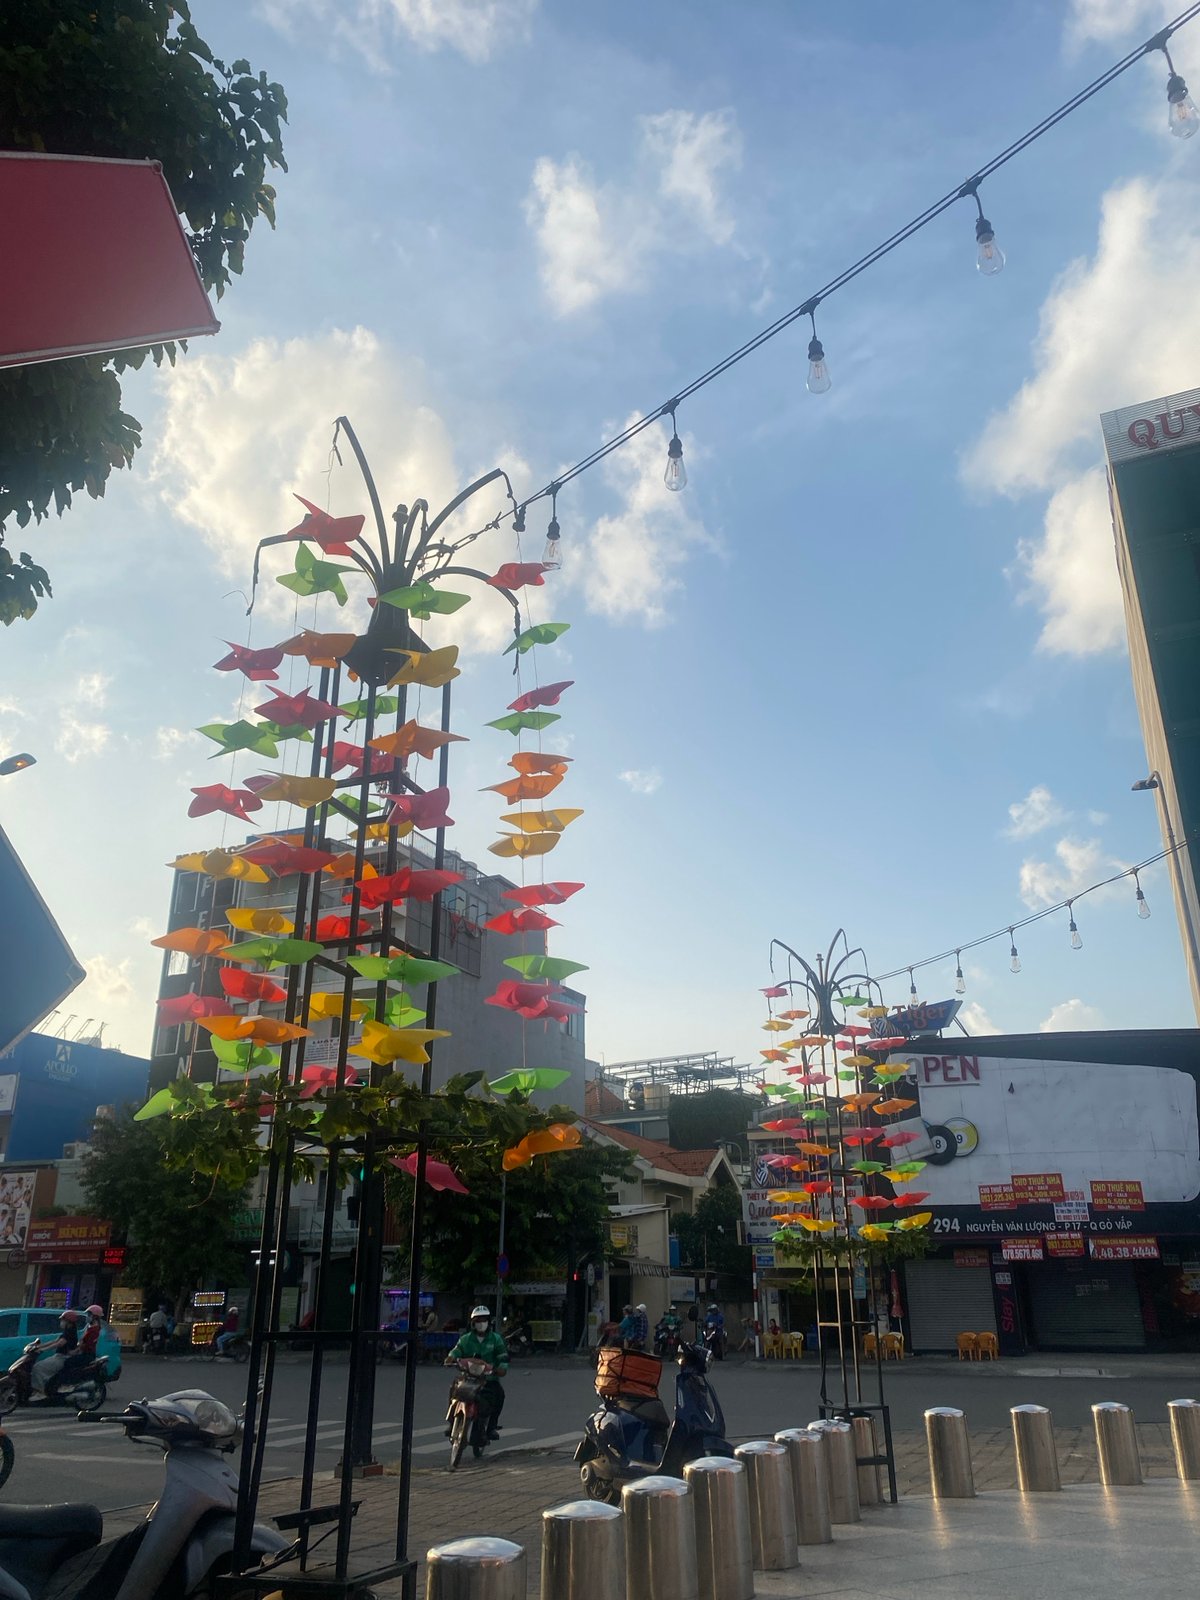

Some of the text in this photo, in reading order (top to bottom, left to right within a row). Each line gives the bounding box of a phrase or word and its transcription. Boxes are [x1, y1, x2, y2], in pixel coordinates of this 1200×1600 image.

[892, 1001, 945, 1028] Tiger
[44, 1060, 78, 1074] APOLLO
[935, 1140, 942, 1149] 8
[956, 1134, 963, 1144] 9
[1014, 1174, 1061, 1186] CHO THUÊ NHÀ
[1092, 1182, 1140, 1192] CHO THUÊ NHÀ
[933, 1217, 961, 1233] 294
[966, 1219, 1004, 1232] NGUYỄN
[1005, 1220, 1023, 1232] VĂN
[1025, 1221, 1056, 1233] LƯỢNG
[1114, 1215, 1133, 1230] VẤP
[58, 1224, 88, 1239] BÌNH
[88, 1225, 107, 1238] AN
